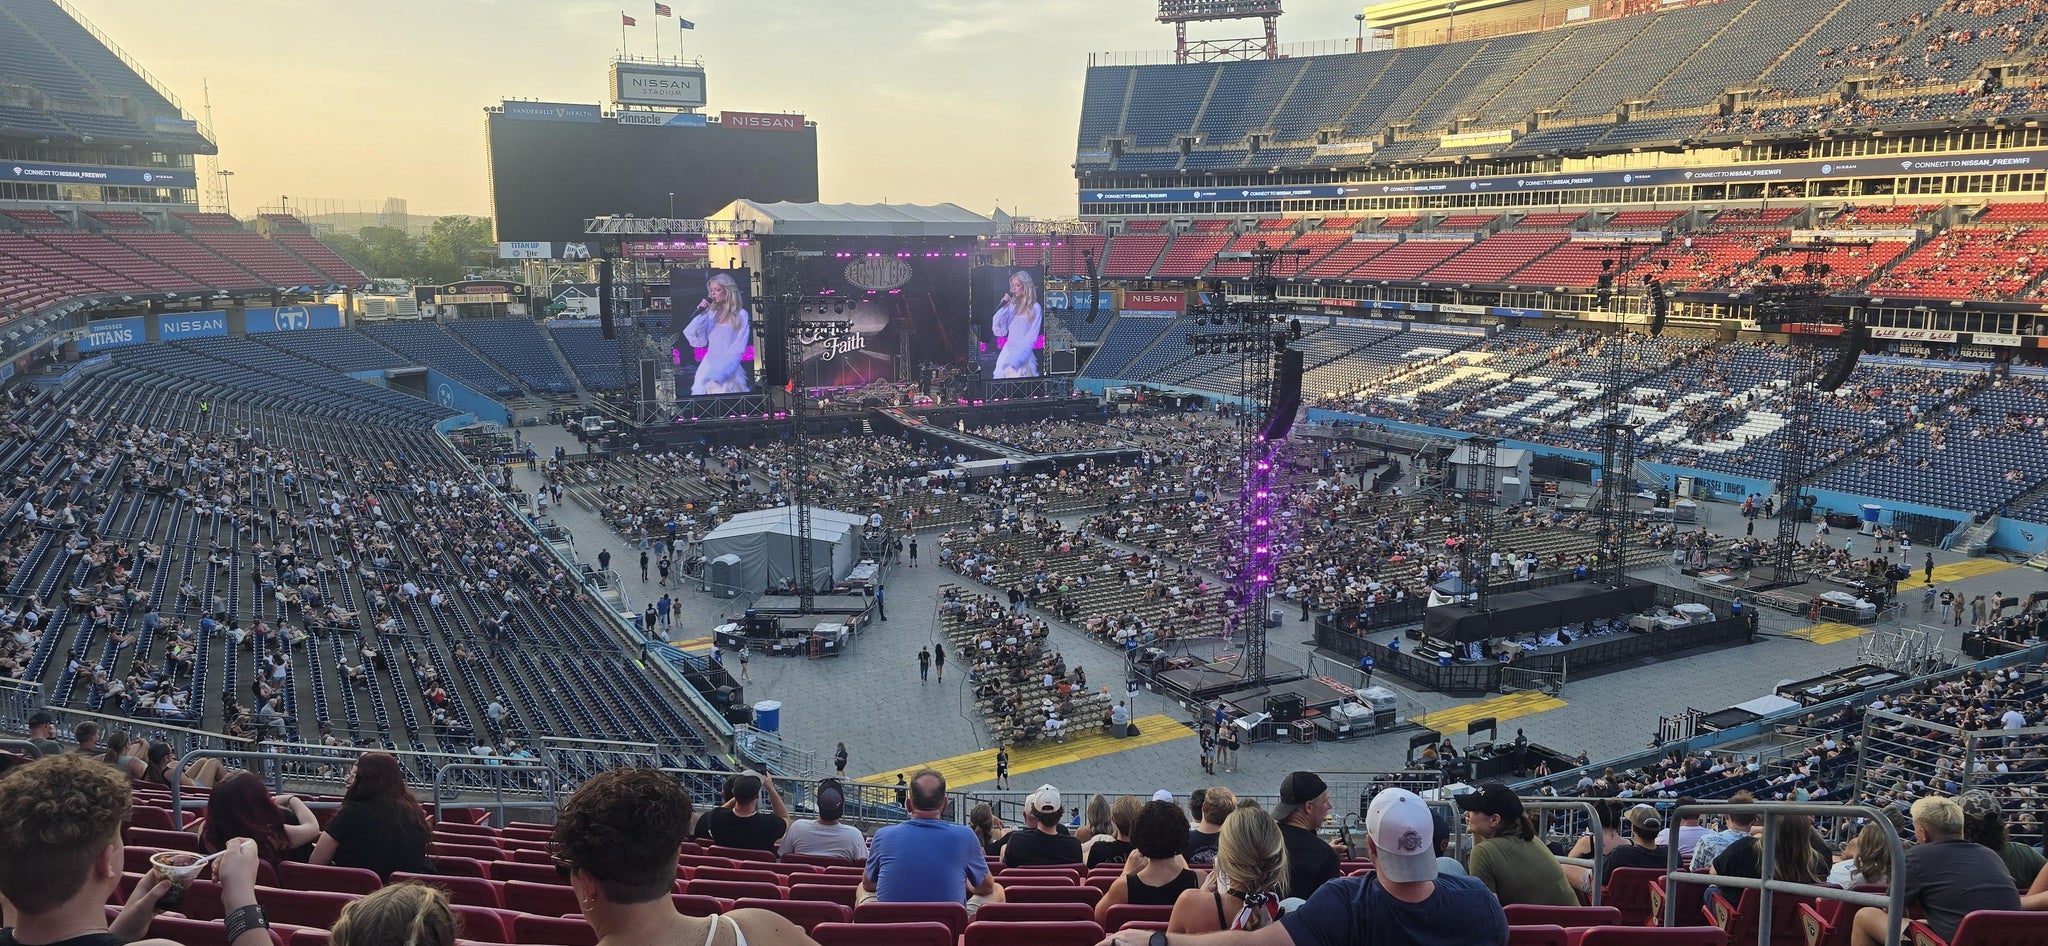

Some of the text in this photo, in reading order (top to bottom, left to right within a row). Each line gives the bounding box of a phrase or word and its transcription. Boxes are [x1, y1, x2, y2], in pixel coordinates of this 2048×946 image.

[632, 78, 691, 89] NISSAN
[642, 88, 682, 96] STADIUM
[618, 112, 661, 125] Pinnacle
[732, 116, 794, 128] NISSAN
[1915, 160, 1950, 169] CONNECT
[1694, 171, 1721, 179] CONNECT
[1132, 295, 1177, 303] NISSAN
[93, 323, 123, 331] TENNESSEE
[164, 318, 223, 333] NISSAN
[89, 329, 133, 347] TITANS
[822, 331, 866, 361] Faith
[1899, 346, 1931, 355] BETHEA
[1960, 350, 1996, 359] BRAZILE
